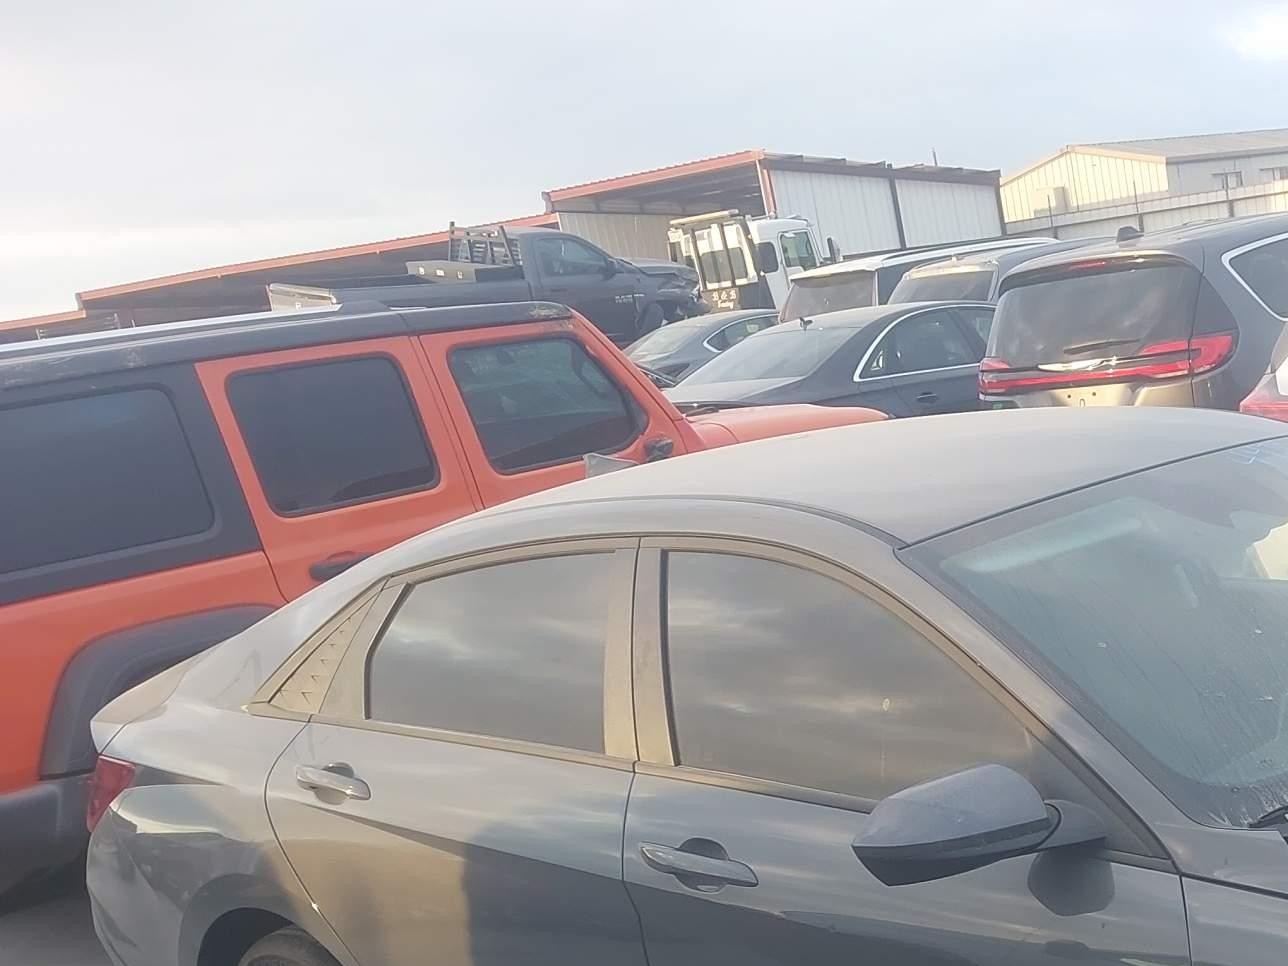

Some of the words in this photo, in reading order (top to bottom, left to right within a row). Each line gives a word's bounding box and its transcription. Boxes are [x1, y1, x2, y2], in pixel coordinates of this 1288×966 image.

[712, 291, 720, 301] B
[720, 290, 728, 300] &
[729, 289, 737, 300] B
